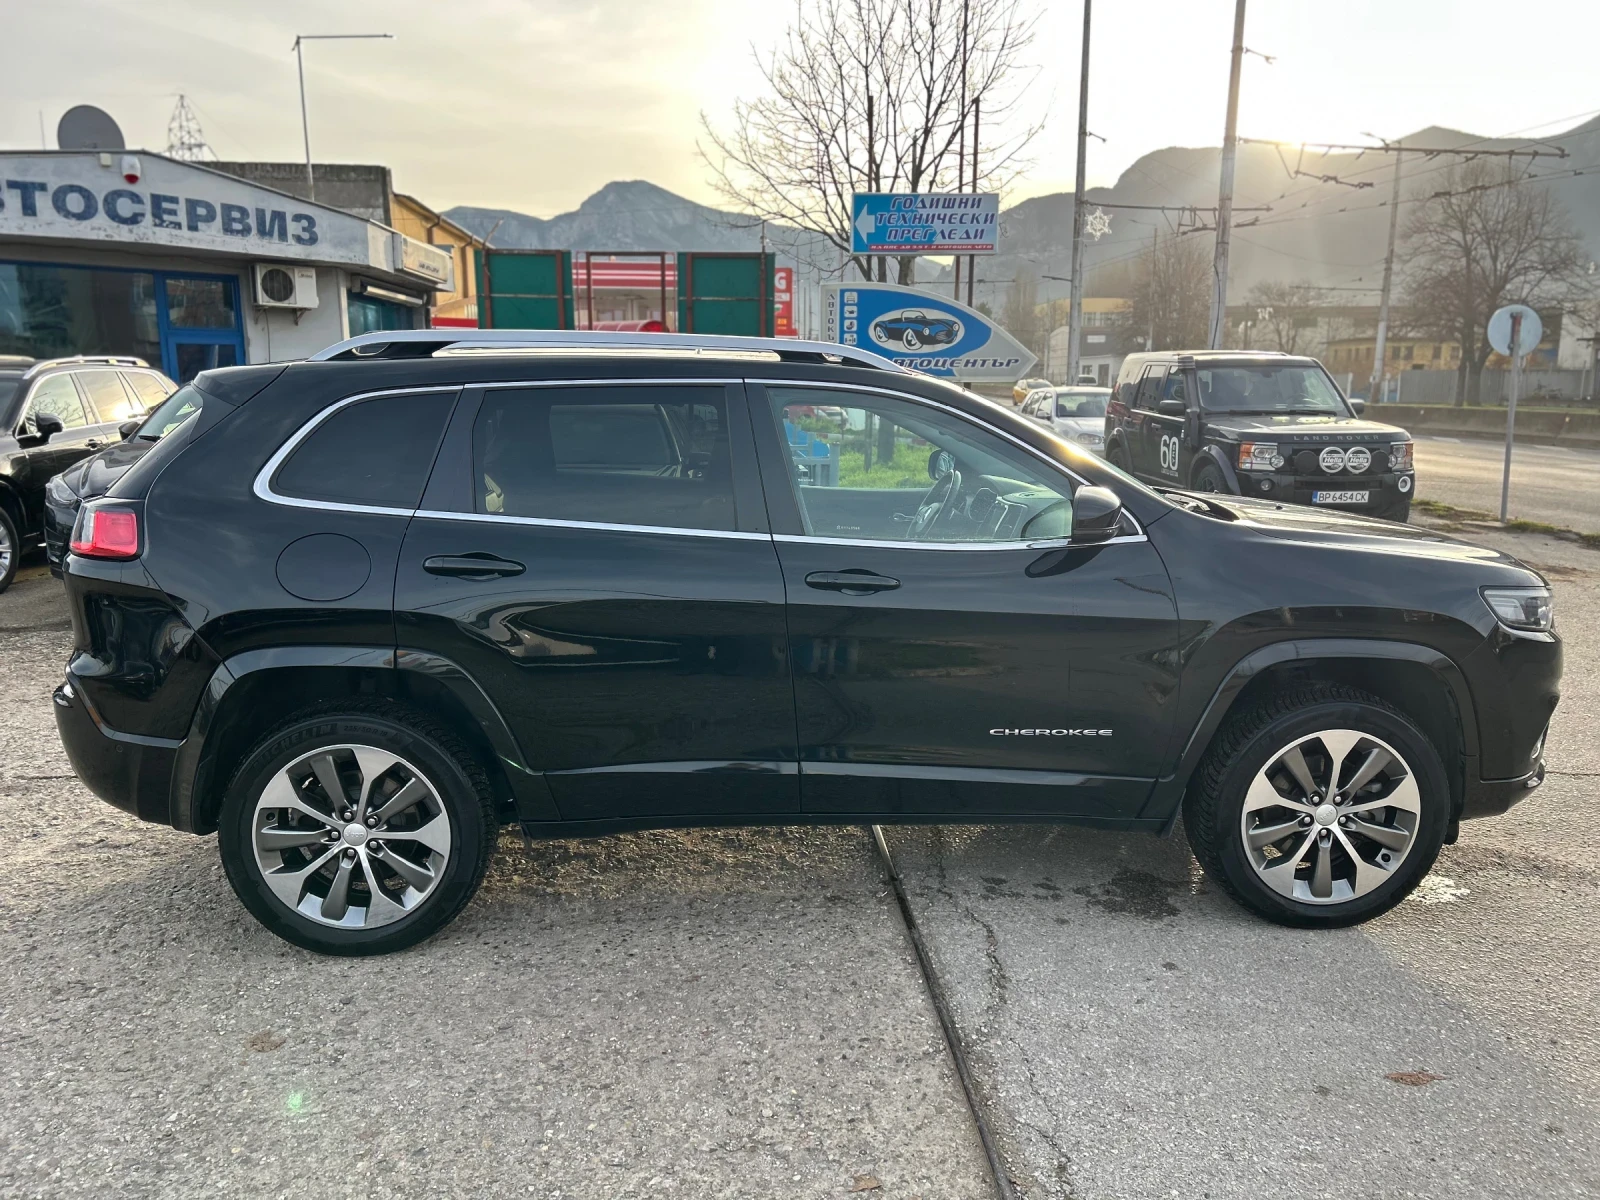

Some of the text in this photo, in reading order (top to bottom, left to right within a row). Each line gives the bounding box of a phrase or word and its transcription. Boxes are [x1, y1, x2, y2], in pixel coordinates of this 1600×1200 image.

[890, 196, 983, 210] ГОДИШНИ
[0, 179, 320, 246] ТОСЕРВИЗ
[876, 212, 996, 226] ТЕХНИЧЕСКИ
[886, 227, 986, 241] ПРЕГЛЕДИ
[827, 293, 836, 341] АВТОКЪ
[892, 357, 1020, 369] ВТОЦЕНТЪР
[1160, 434, 1179, 471] 60
[1318, 493, 1331, 502] BP
[1332, 493, 1354, 502] 6454
[1355, 493, 1367, 502] CK
[989, 728, 1114, 736] CHEROKEE
